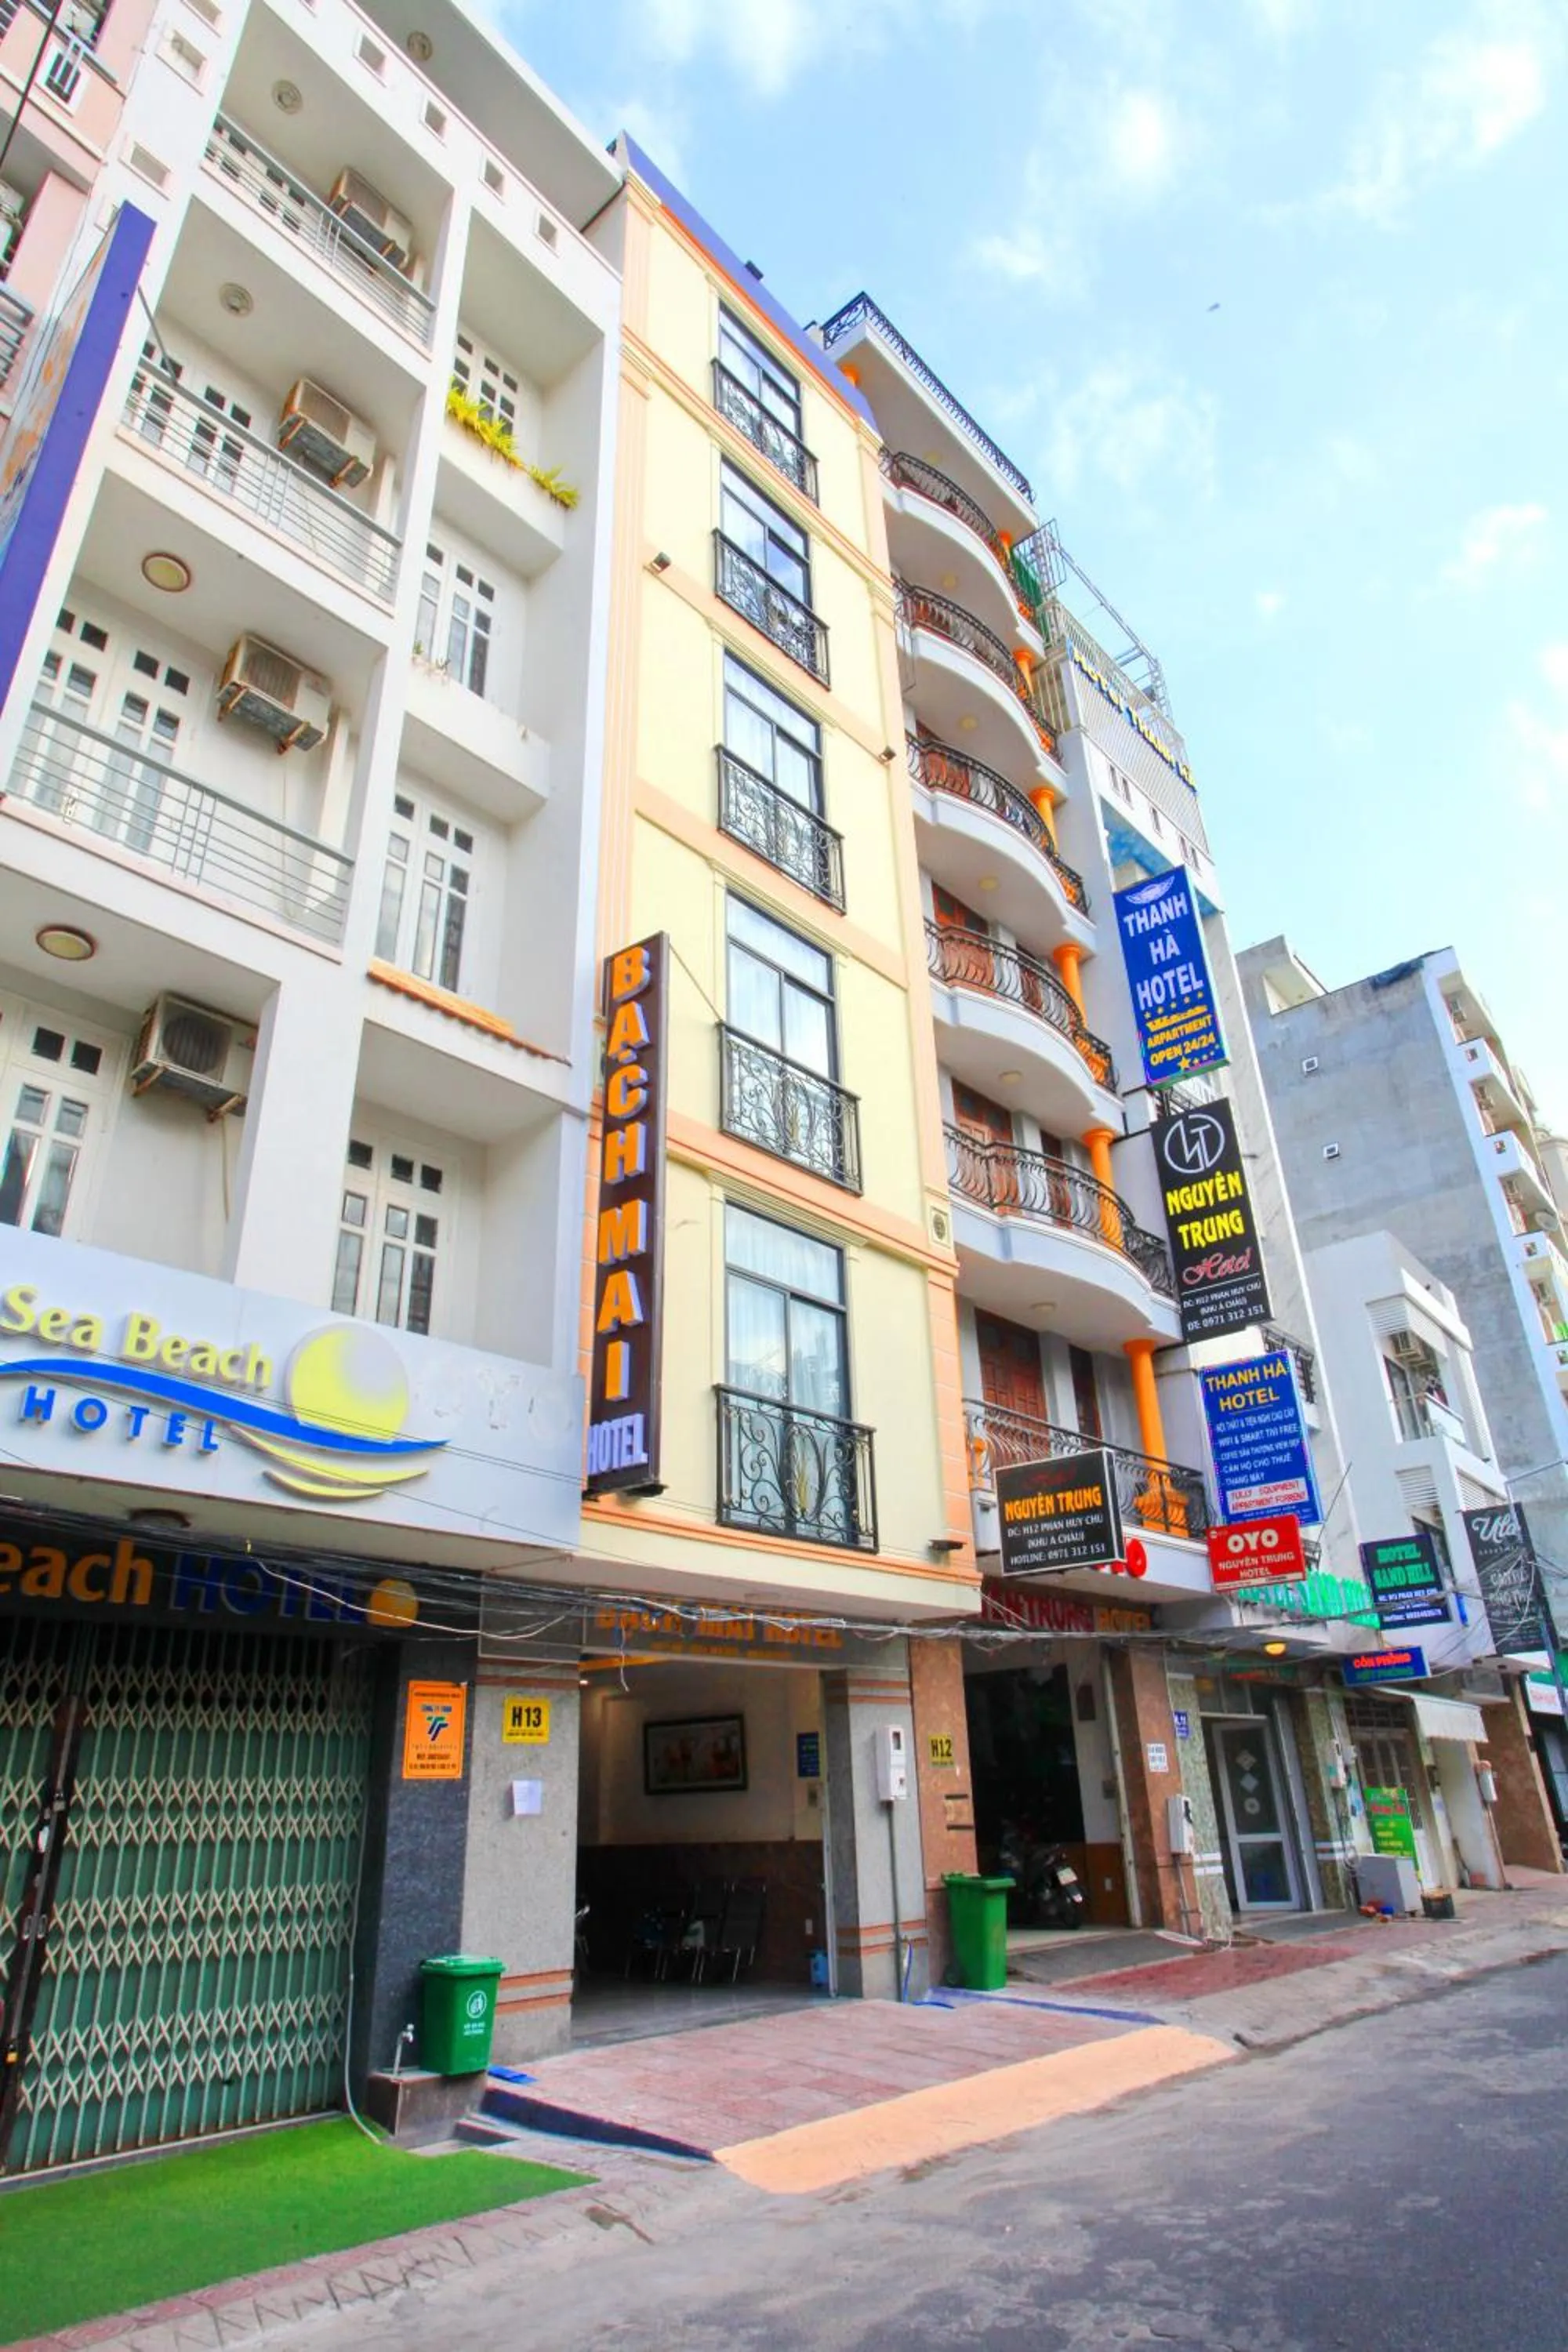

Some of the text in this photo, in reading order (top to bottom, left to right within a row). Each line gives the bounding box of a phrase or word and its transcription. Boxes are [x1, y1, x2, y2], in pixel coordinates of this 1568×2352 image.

[1123, 891, 1189, 937] THANH
[1149, 928, 1181, 964] HÀ
[1136, 963, 1203, 1010] HOTEL
[1150, 1044, 1182, 1065] OPEN
[1178, 1209, 1245, 1250] TRUNG
[1247, 1305, 1265, 1316] 151
[0, 1284, 276, 1391] Sea Beach
[1206, 1358, 1287, 1392] THANH HÀ
[1219, 1386, 1279, 1411] HOTEL
[20, 1385, 220, 1456] HOTEL
[587, 1414, 648, 1477] HOTEL
[1057, 1485, 1102, 1513] TRUNG
[1228, 1529, 1279, 1553] OYO
[1240, 1566, 1272, 1579] HOTEL
[1261, 1552, 1295, 1565] TRUNG
[168, 1550, 362, 1625] HOTEL
[512, 1706, 542, 1728] H13
[931, 1738, 952, 1757] H12
